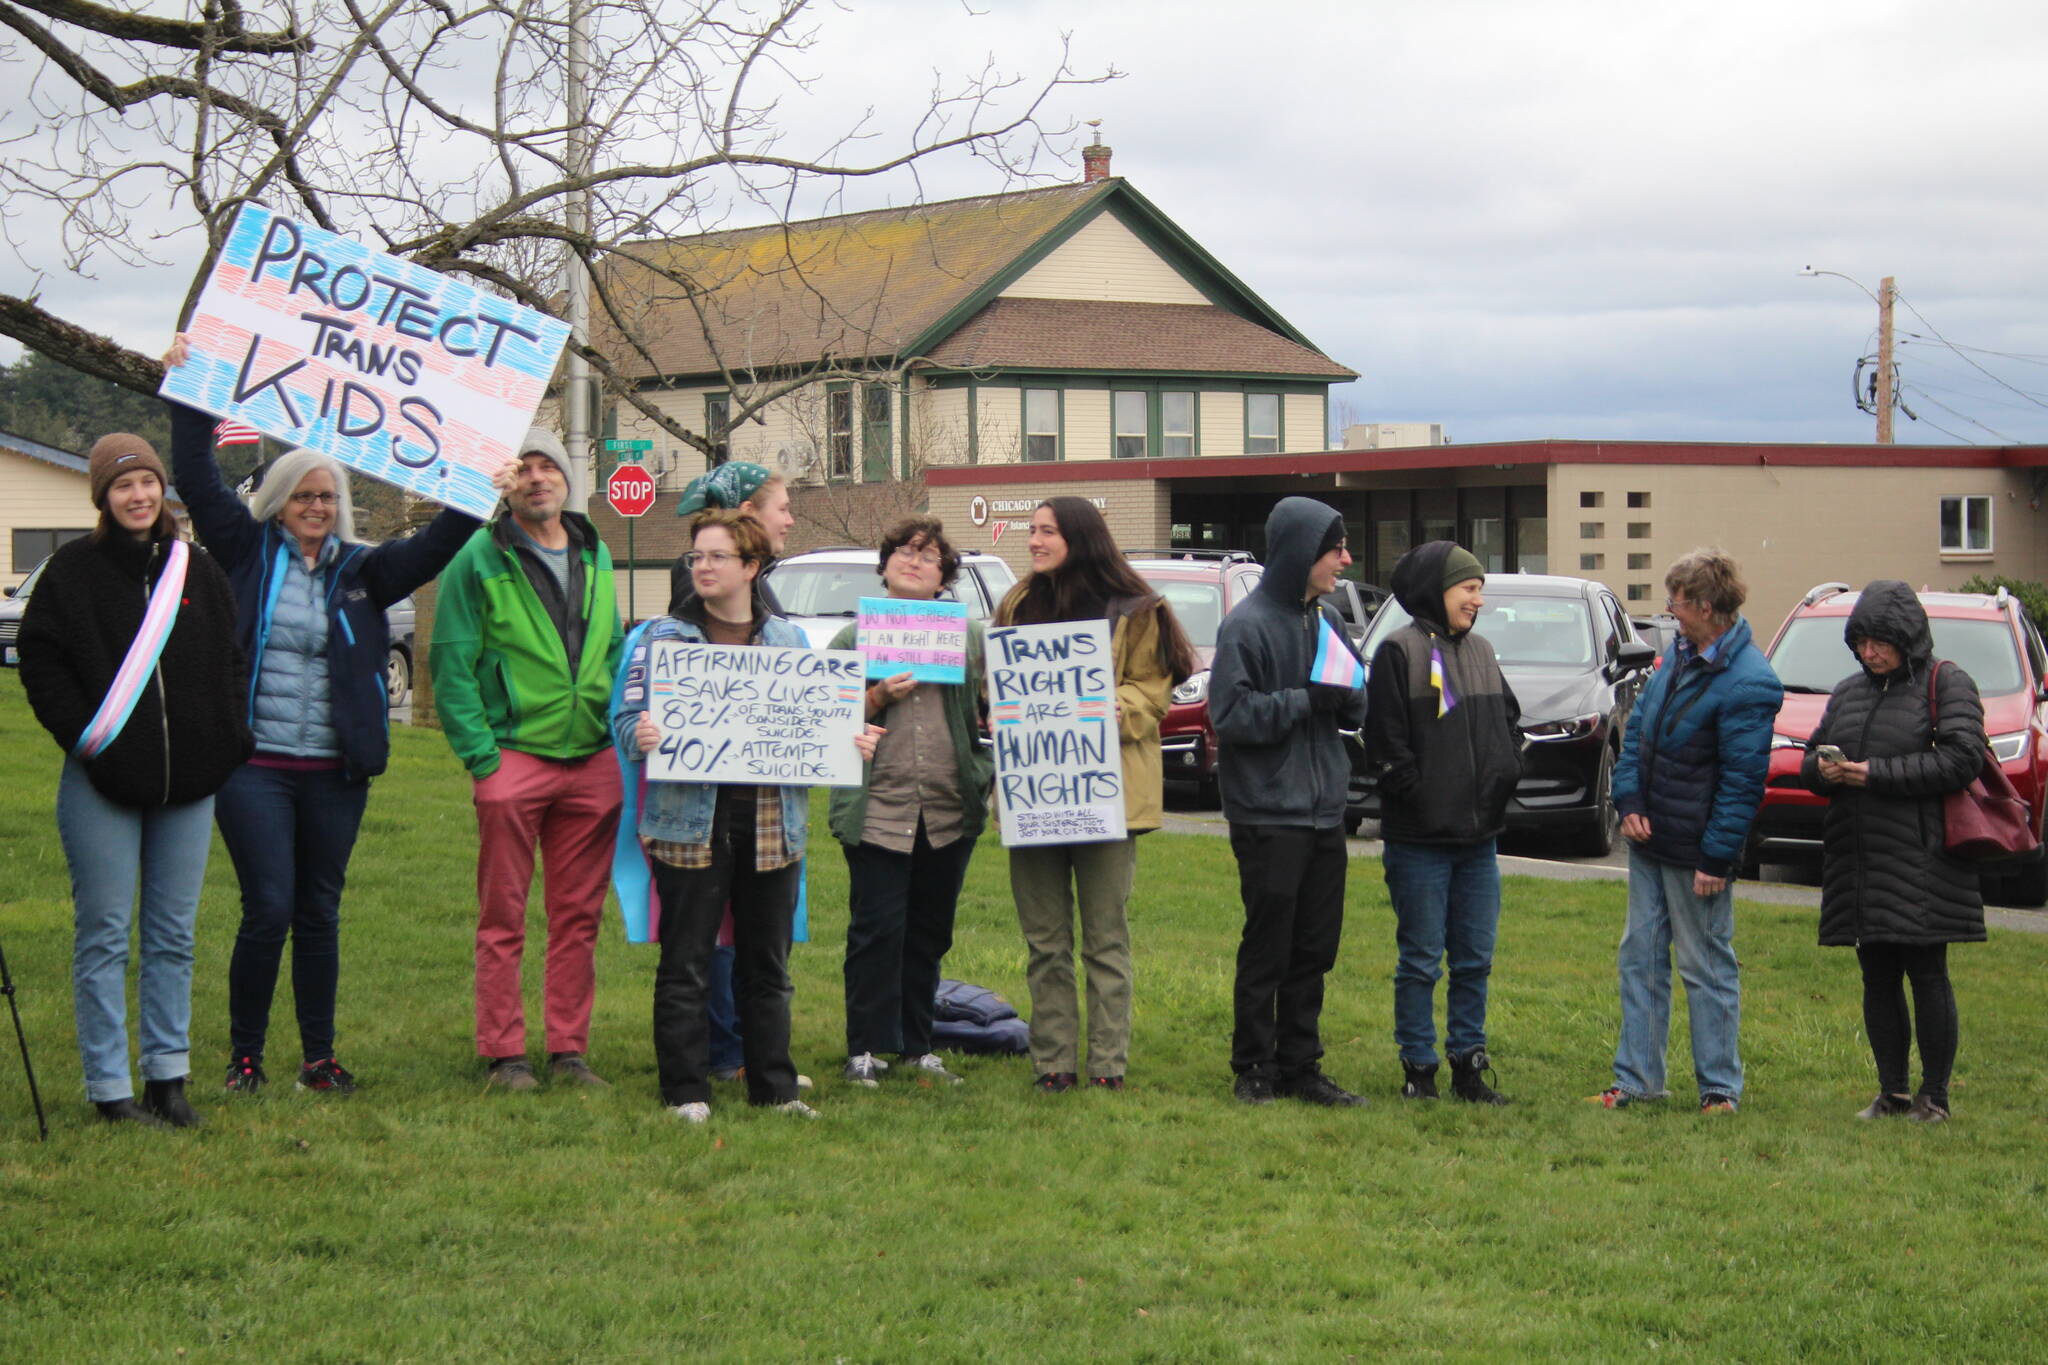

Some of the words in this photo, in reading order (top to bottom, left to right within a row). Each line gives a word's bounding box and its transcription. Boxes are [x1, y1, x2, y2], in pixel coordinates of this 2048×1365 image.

[251, 216, 540, 367] PROTECT
[301, 313, 423, 386] TRANS
[233, 334, 449, 478] KIDS.
[613, 441, 632, 449] FIRST
[611, 481, 652, 500] STOP
[992, 499, 1031, 512] CHICAGO
[865, 606, 879, 625] DO
[886, 604, 908, 625] NOT
[878, 632, 893, 645] AM
[903, 631, 932, 646] RIGHT
[988, 628, 1097, 665] TRANS
[656, 647, 793, 678] AFFIRMING
[796, 653, 863, 679] CARE
[875, 653, 889, 665] AM
[897, 652, 925, 665] STILL
[677, 676, 759, 702] SAVES
[767, 679, 838, 704] LIVES.
[993, 665, 1105, 700] RIGHTS
[662, 699, 731, 730] 82%
[738, 703, 760, 714] OF
[764, 704, 803, 715] TRANS
[808, 705, 852, 719] YOUTH
[746, 714, 827, 728] CONSIDER
[1025, 701, 1072, 724] ARE
[659, 735, 731, 773] 40%
[741, 740, 829, 760] ATTEMPT
[997, 719, 1106, 771] HUMAN
[747, 760, 836, 778] SUICIDE.
[1000, 770, 1119, 811] RIGHTS
[1016, 812, 1052, 821] STAND
[1053, 809, 1074, 819] WITH
[1077, 809, 1096, 818] ALL
[1083, 819, 1105, 827] NOT
